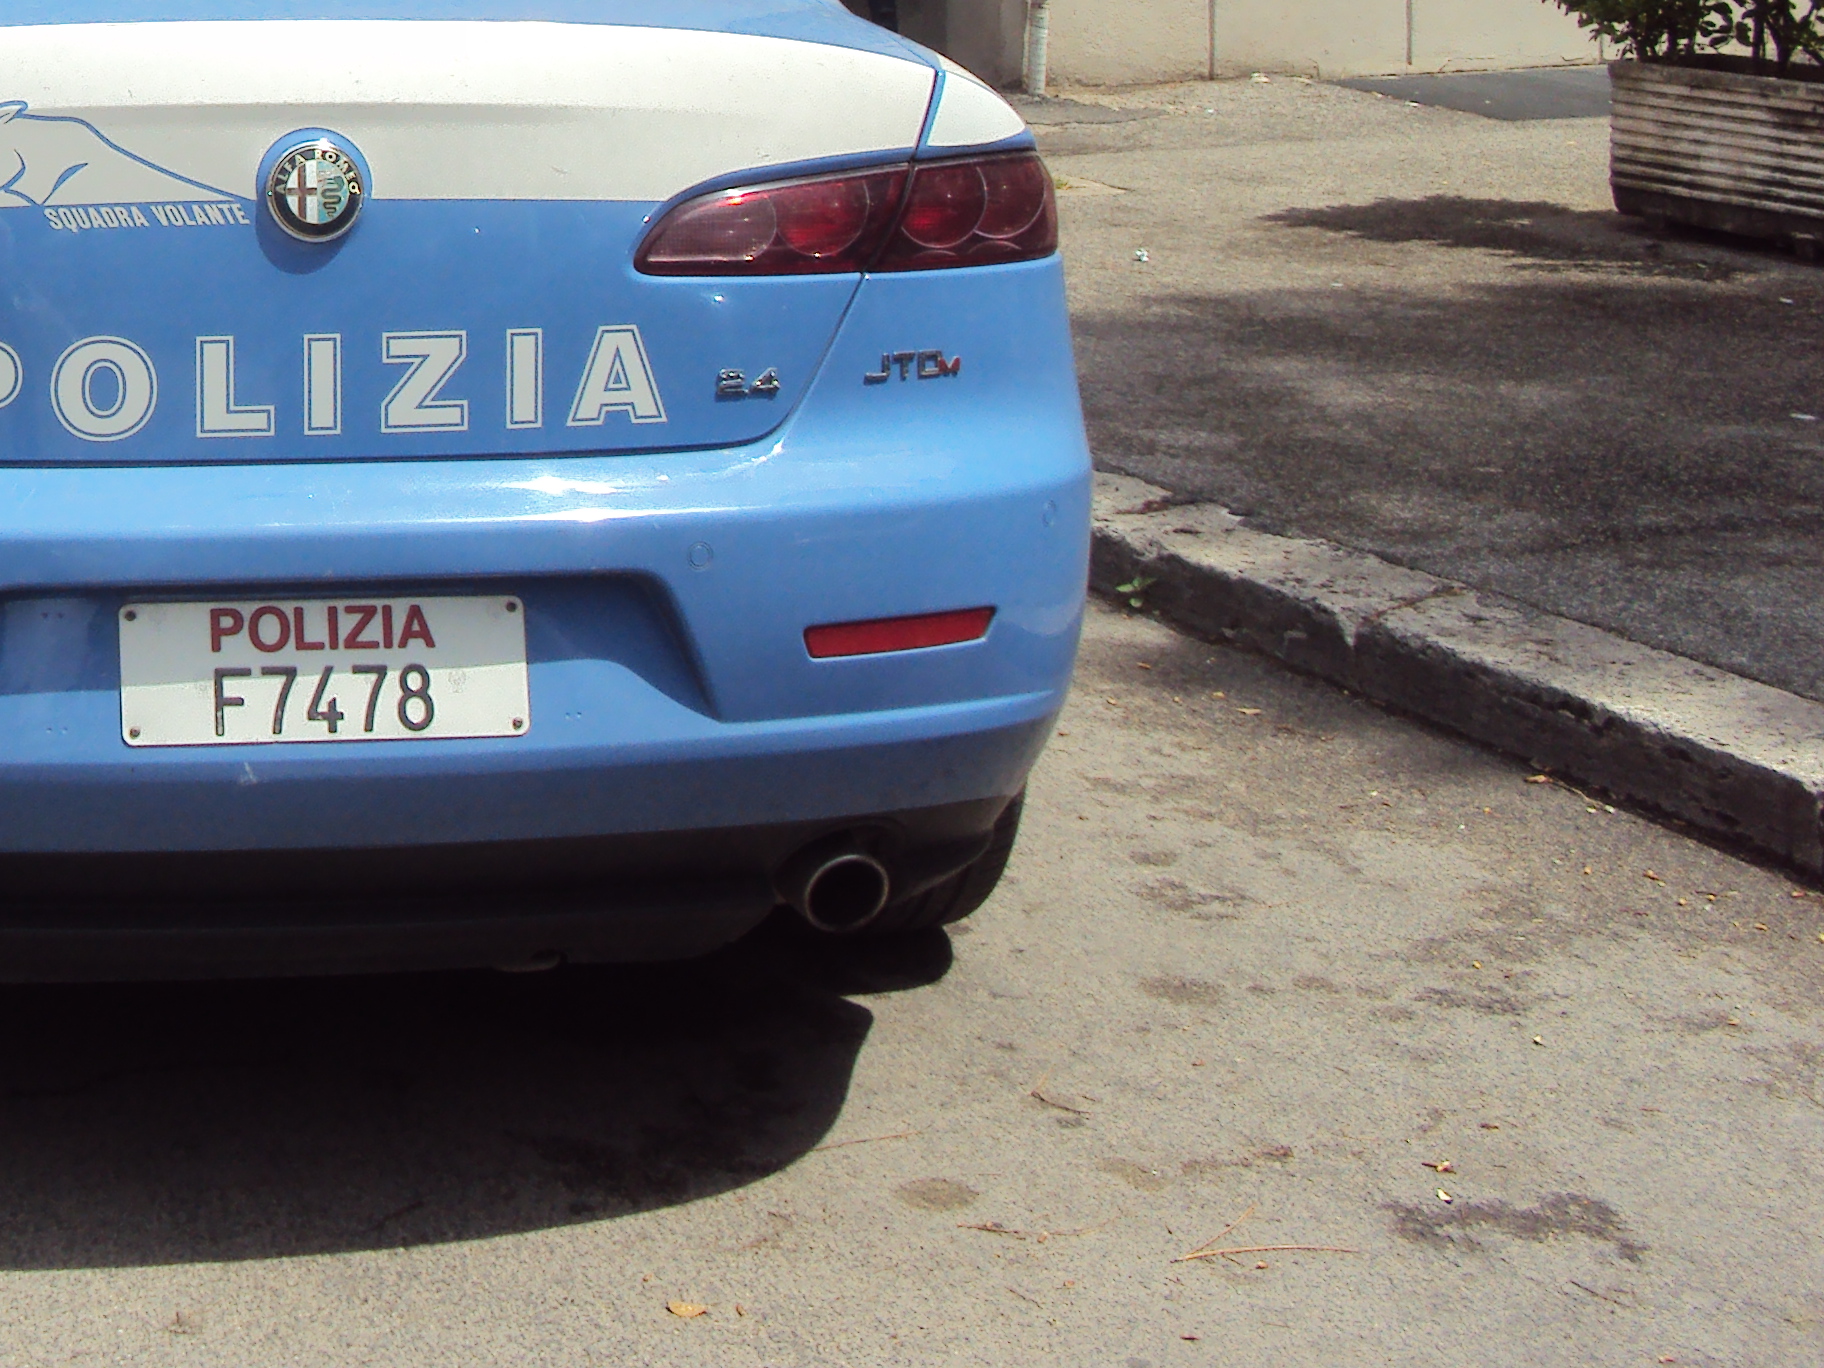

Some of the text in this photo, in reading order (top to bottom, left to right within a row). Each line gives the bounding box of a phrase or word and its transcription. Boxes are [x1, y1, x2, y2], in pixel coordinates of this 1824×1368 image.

[275, 149, 361, 195] ALFA ROMEO
[44, 203, 251, 233] SQUADRA VOLANTE
[210, 604, 436, 653] POLIZIA
[214, 663, 435, 737] F7478
